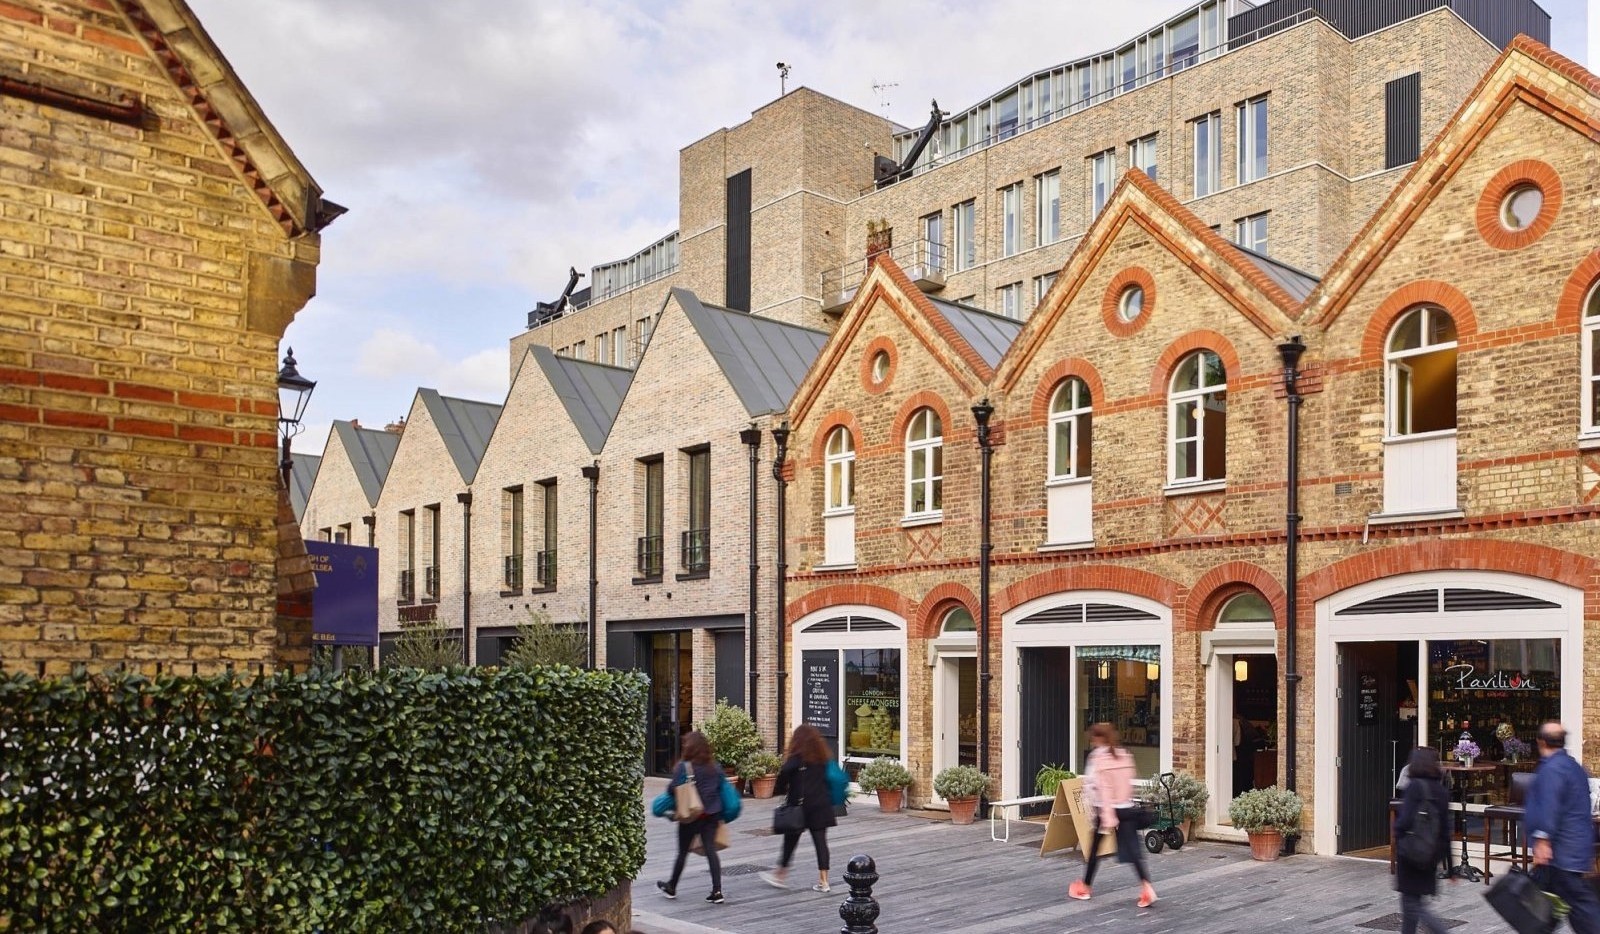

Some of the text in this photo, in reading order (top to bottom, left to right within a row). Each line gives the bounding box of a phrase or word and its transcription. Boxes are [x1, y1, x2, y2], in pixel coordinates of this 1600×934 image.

[311, 563, 333, 572] ELSEA
[1444, 664, 1535, 688] Pavilion
[847, 698, 899, 707] CHEESEMONGERS
